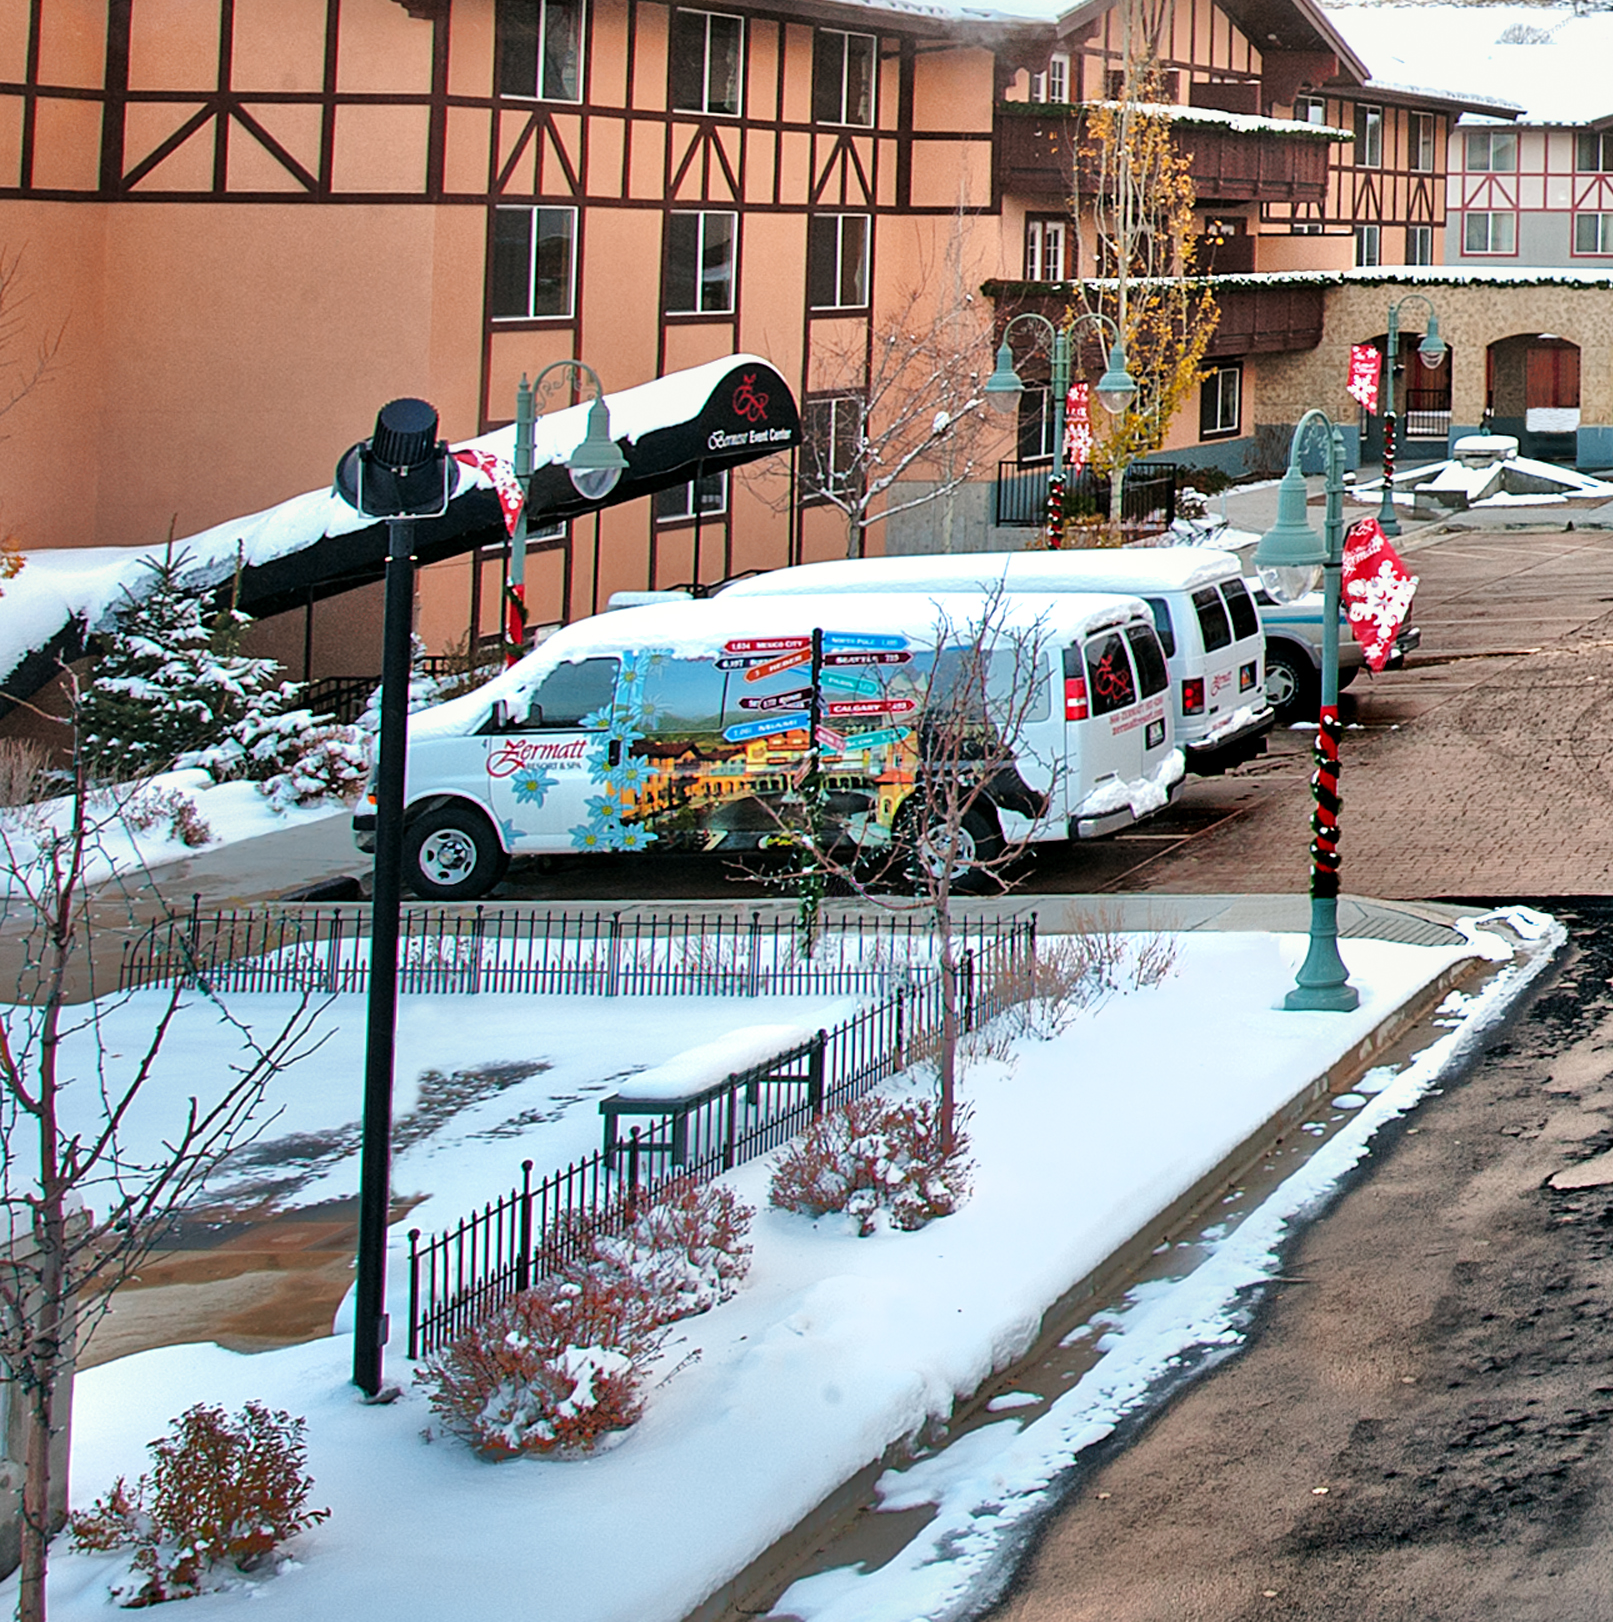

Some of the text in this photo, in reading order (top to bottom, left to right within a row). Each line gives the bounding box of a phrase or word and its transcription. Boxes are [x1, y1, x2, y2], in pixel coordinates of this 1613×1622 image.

[749, 430, 768, 443] Event
[769, 428, 791, 441] Center
[756, 641, 784, 649] MEXICO
[785, 640, 804, 648] CITY
[769, 654, 803, 672] HEBER
[835, 656, 880, 665] SEATTLE
[833, 705, 880, 713] CALGARY
[758, 719, 798, 731] MIAMI
[486, 739, 587, 778] Zermatt
